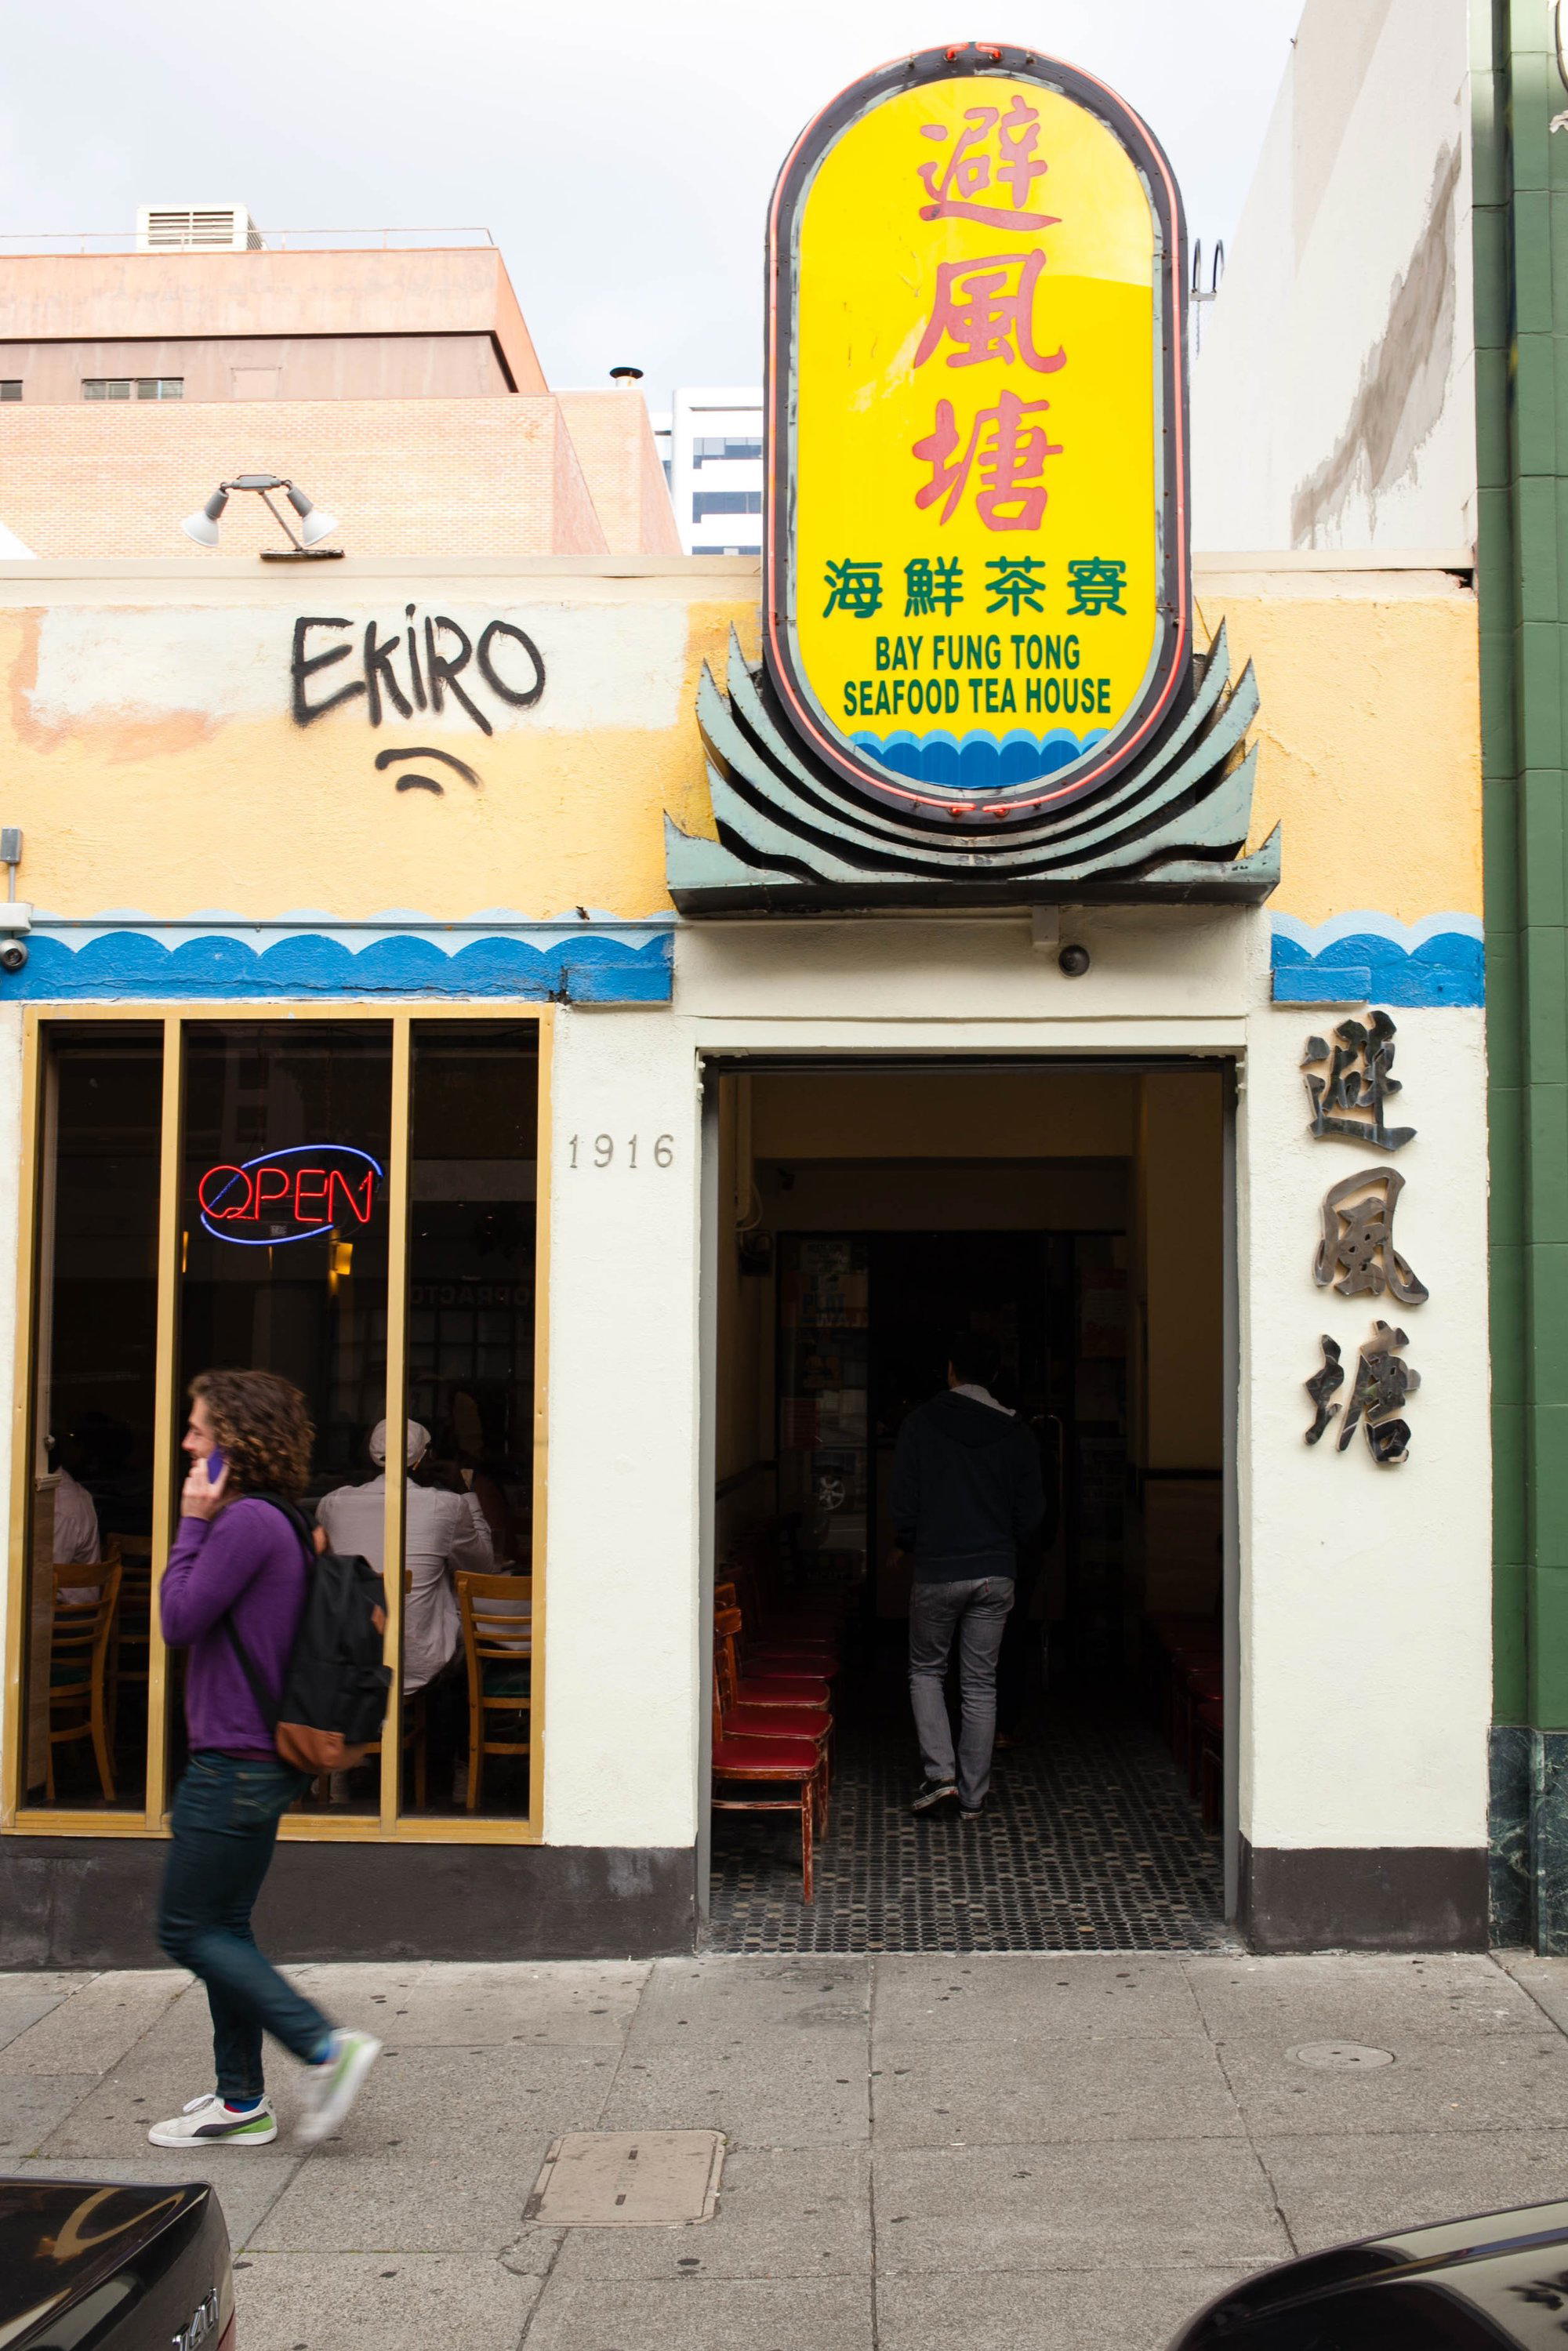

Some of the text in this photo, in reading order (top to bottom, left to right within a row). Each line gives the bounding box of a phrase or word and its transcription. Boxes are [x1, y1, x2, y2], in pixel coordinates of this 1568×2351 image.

[913, 95, 1067, 532] 避風塘
[822, 555, 1127, 619] 海鮮茶寮
[876, 634, 1080, 671] BAY FUNG TONG
[844, 677, 1111, 717] SEAFOOD TEA HOUSE
[569, 1134, 674, 1169] 1916
[198, 1164, 375, 1224] OPEN
